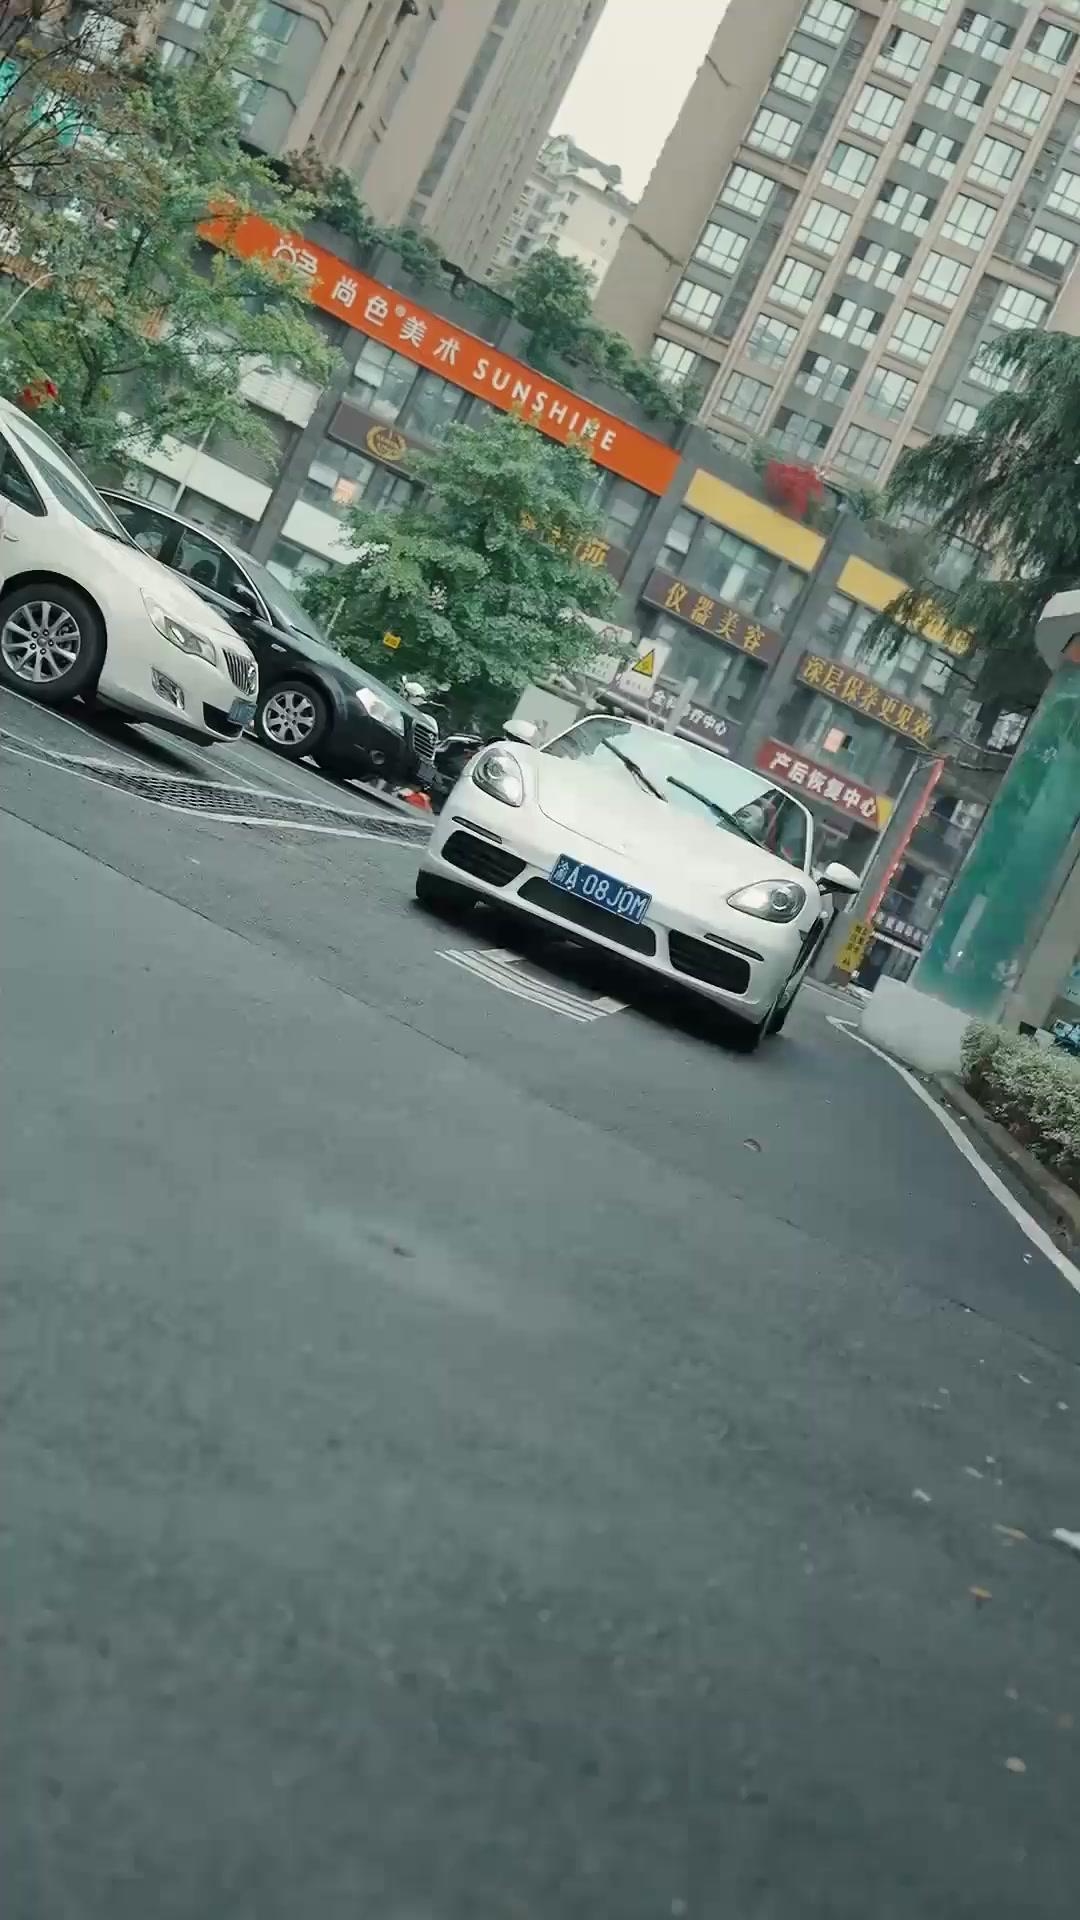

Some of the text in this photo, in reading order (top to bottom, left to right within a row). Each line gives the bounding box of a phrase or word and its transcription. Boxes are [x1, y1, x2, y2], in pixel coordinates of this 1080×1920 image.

[472, 358, 617, 451] SUNSHINE
[664, 582, 766, 652] 仪器美容
[803, 655, 933, 741] 深层保养更见效
[768, 751, 877, 818] 产后恢复中心
